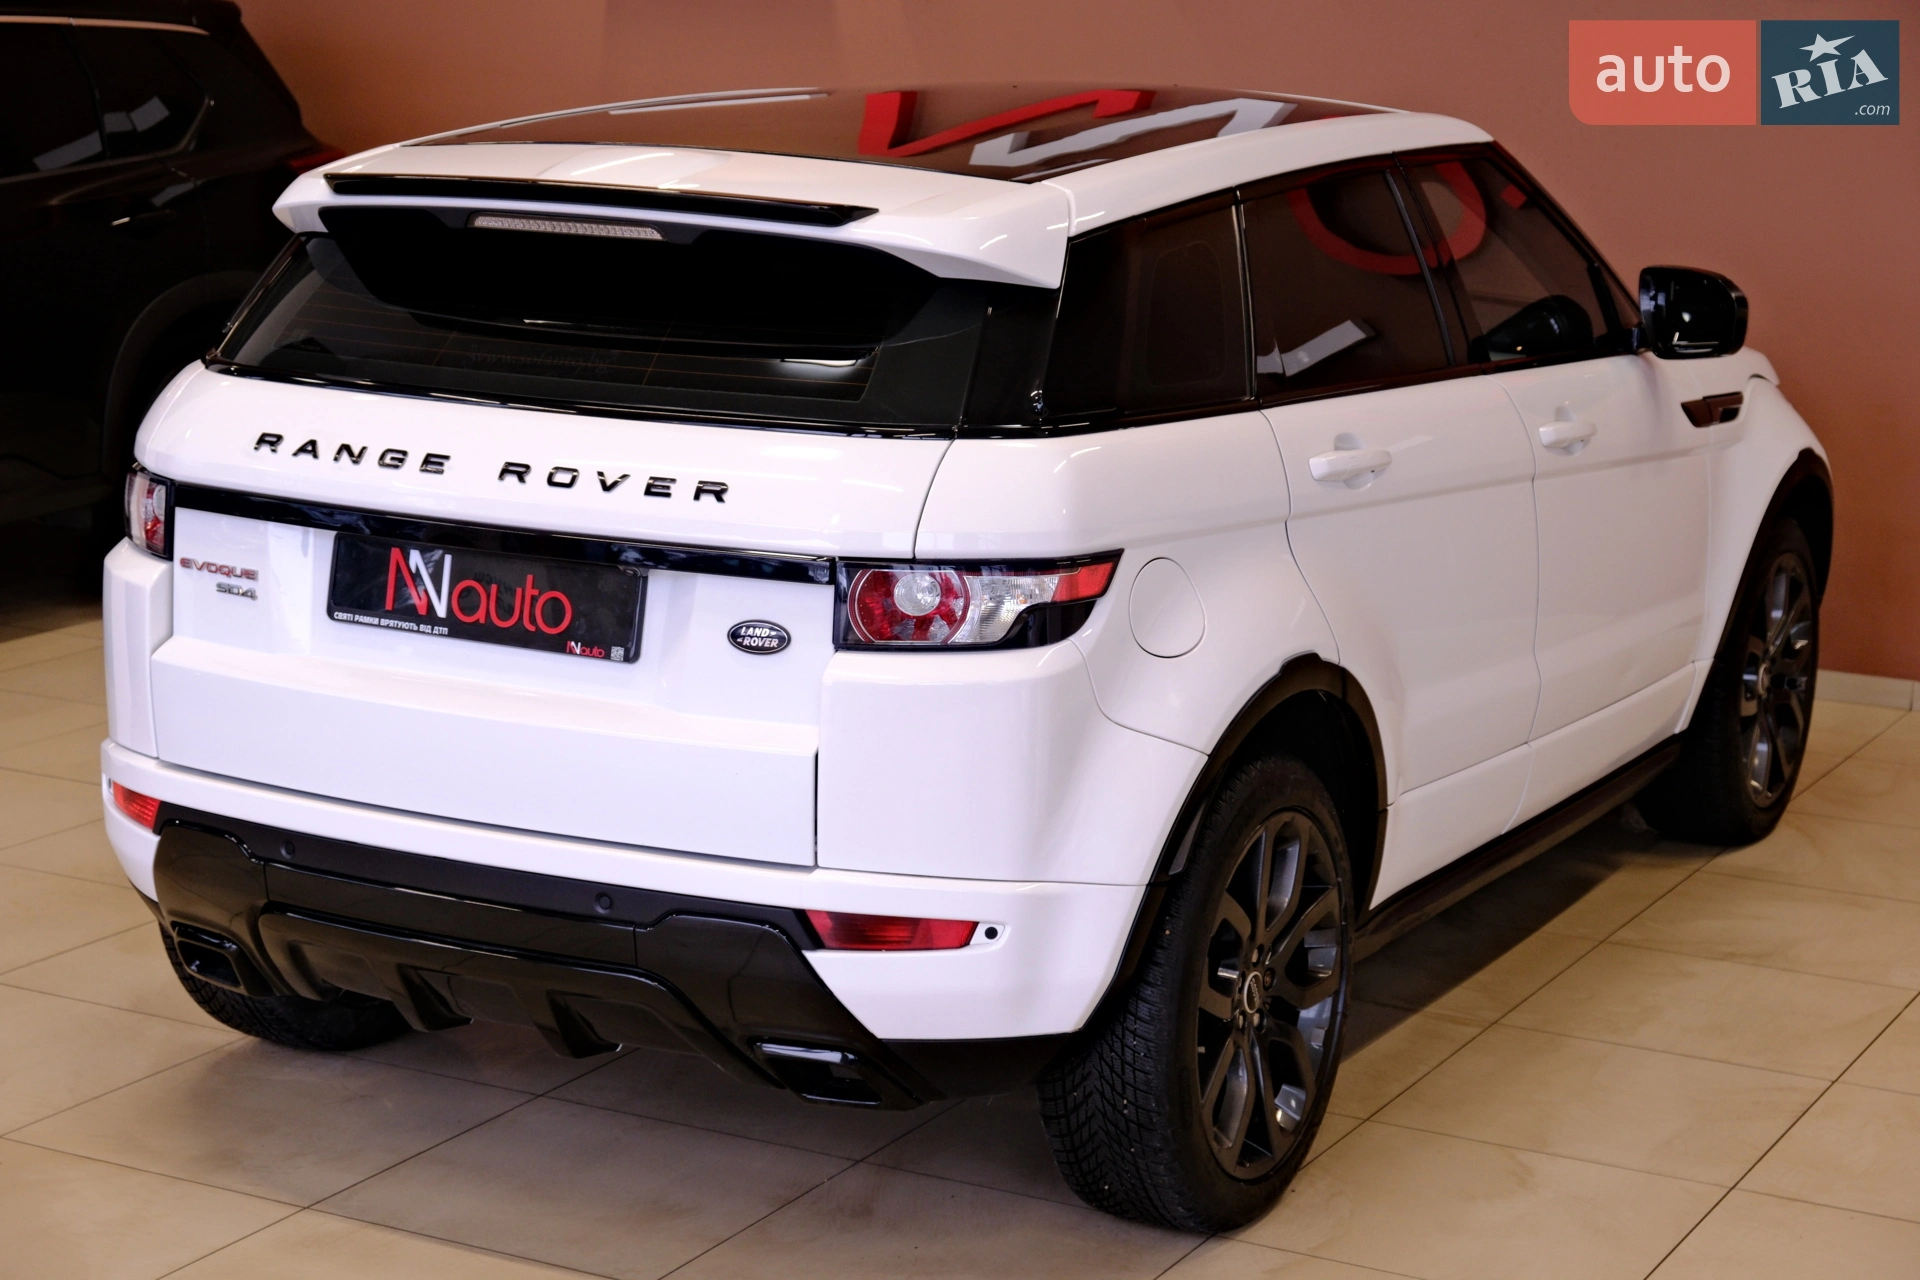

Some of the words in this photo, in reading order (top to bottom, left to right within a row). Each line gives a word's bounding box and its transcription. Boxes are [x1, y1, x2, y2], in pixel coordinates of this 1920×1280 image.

[253, 432, 451, 475] RANGE
[498, 461, 730, 504] ROVER
[179, 557, 259, 581] EVOQUE
[215, 581, 258, 601] SD4
[354, 614, 380, 626] РАМКИ
[740, 626, 770, 637] LAND
[742, 636, 779, 648] ROVER
